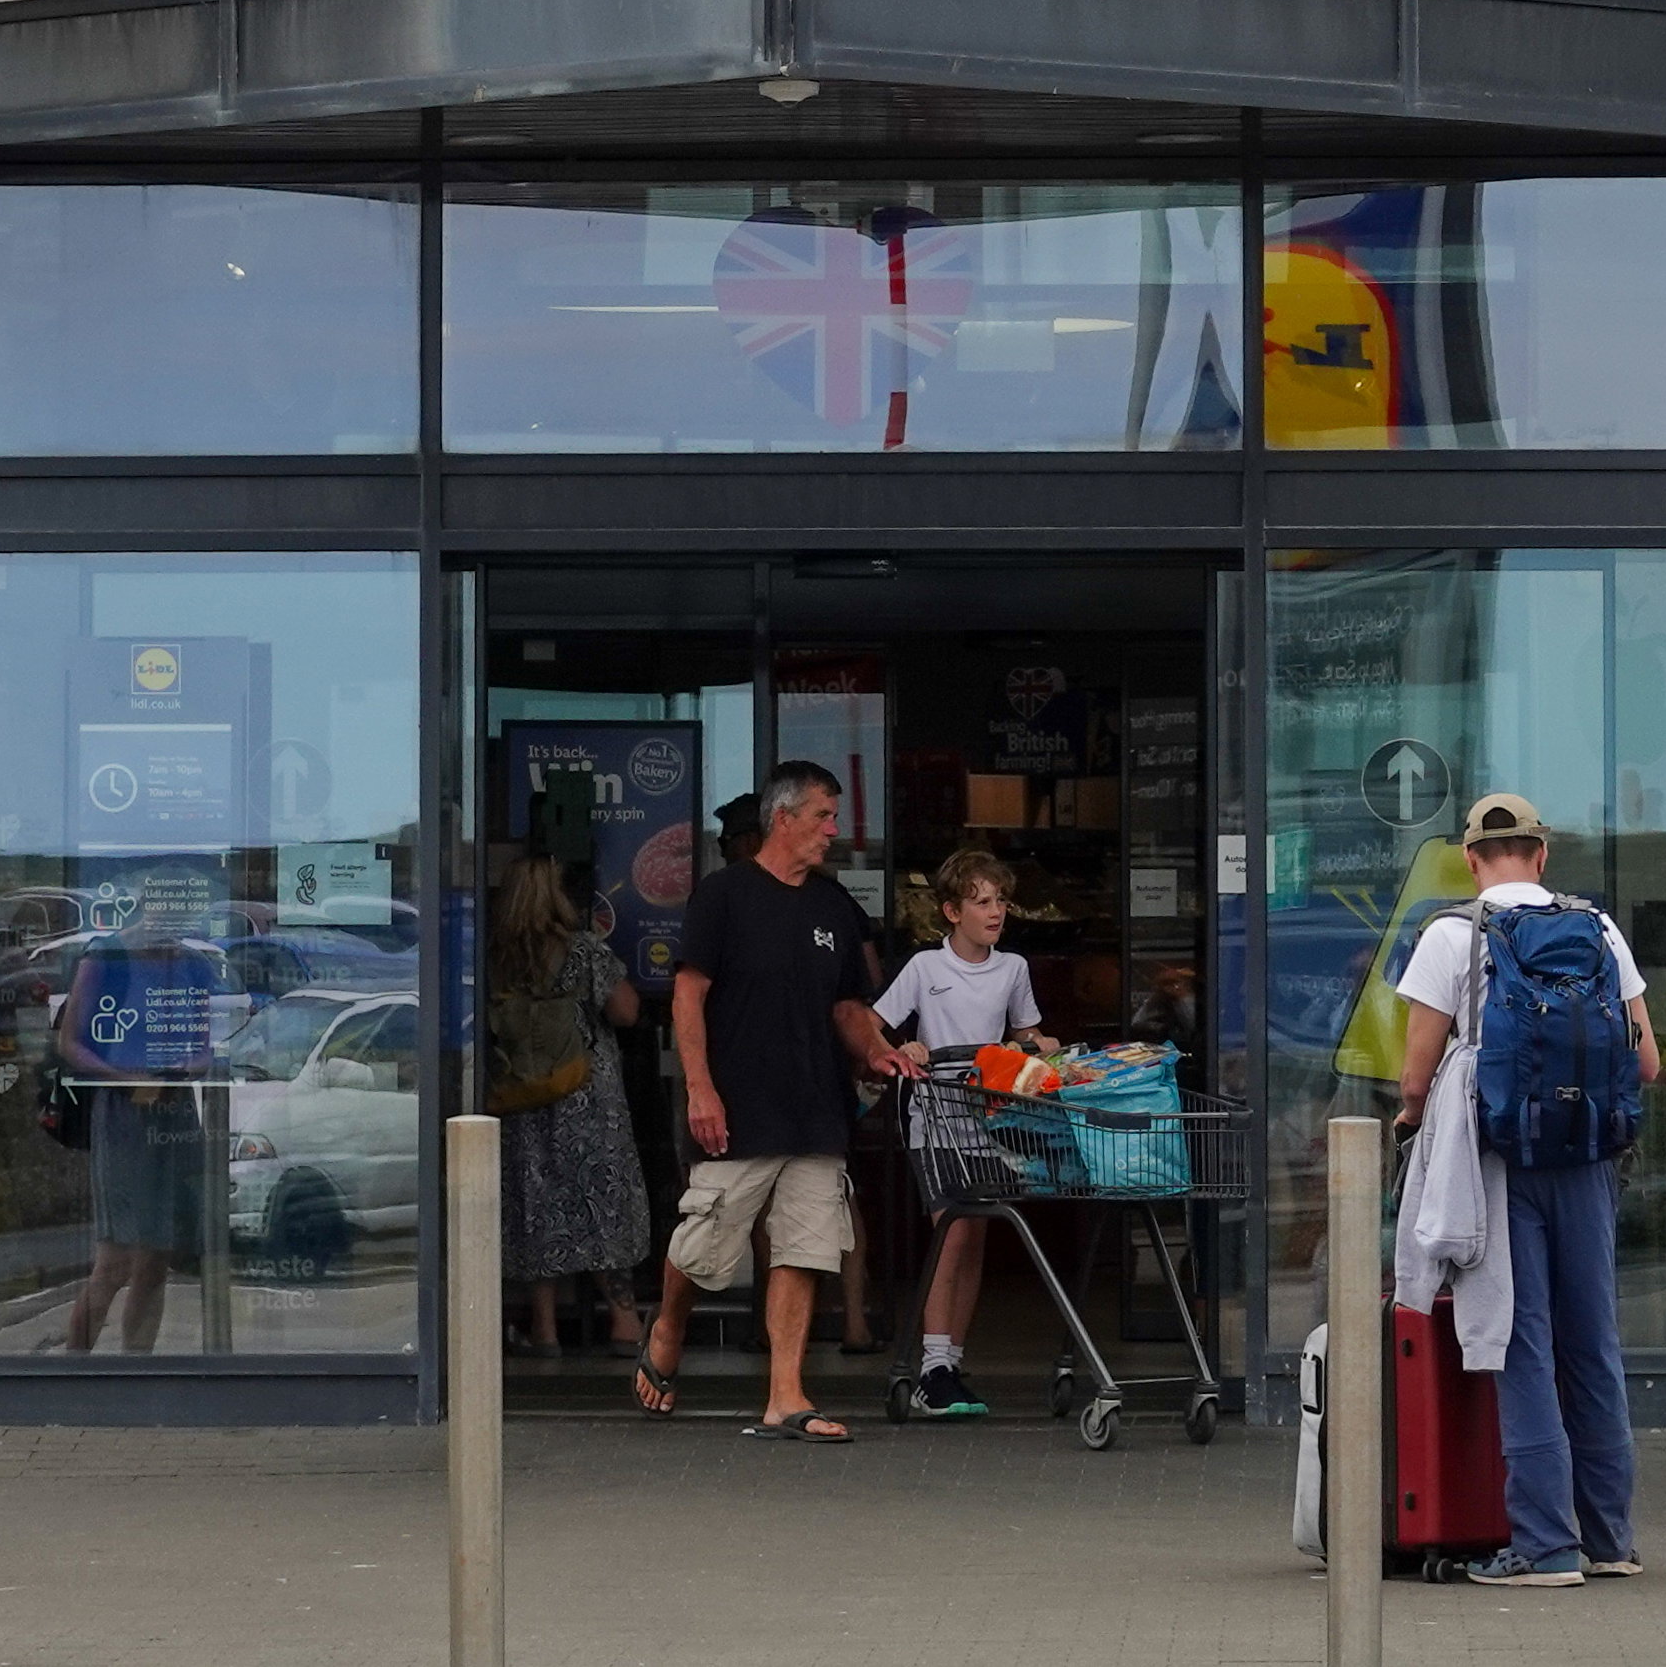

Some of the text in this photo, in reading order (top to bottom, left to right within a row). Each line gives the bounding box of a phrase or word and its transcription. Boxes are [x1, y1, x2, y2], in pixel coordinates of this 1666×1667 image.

[131, 699, 181, 710] lidl.co.uk
[1007, 730, 1068, 752] British
[528, 745, 598, 759] It's back...
[995, 752, 1051, 773] farming!
[634, 762, 678, 783] Bakery
[615, 808, 645, 822] spin
[145, 877, 209, 886] Customer Care
[146, 987, 209, 996] Customer Care
